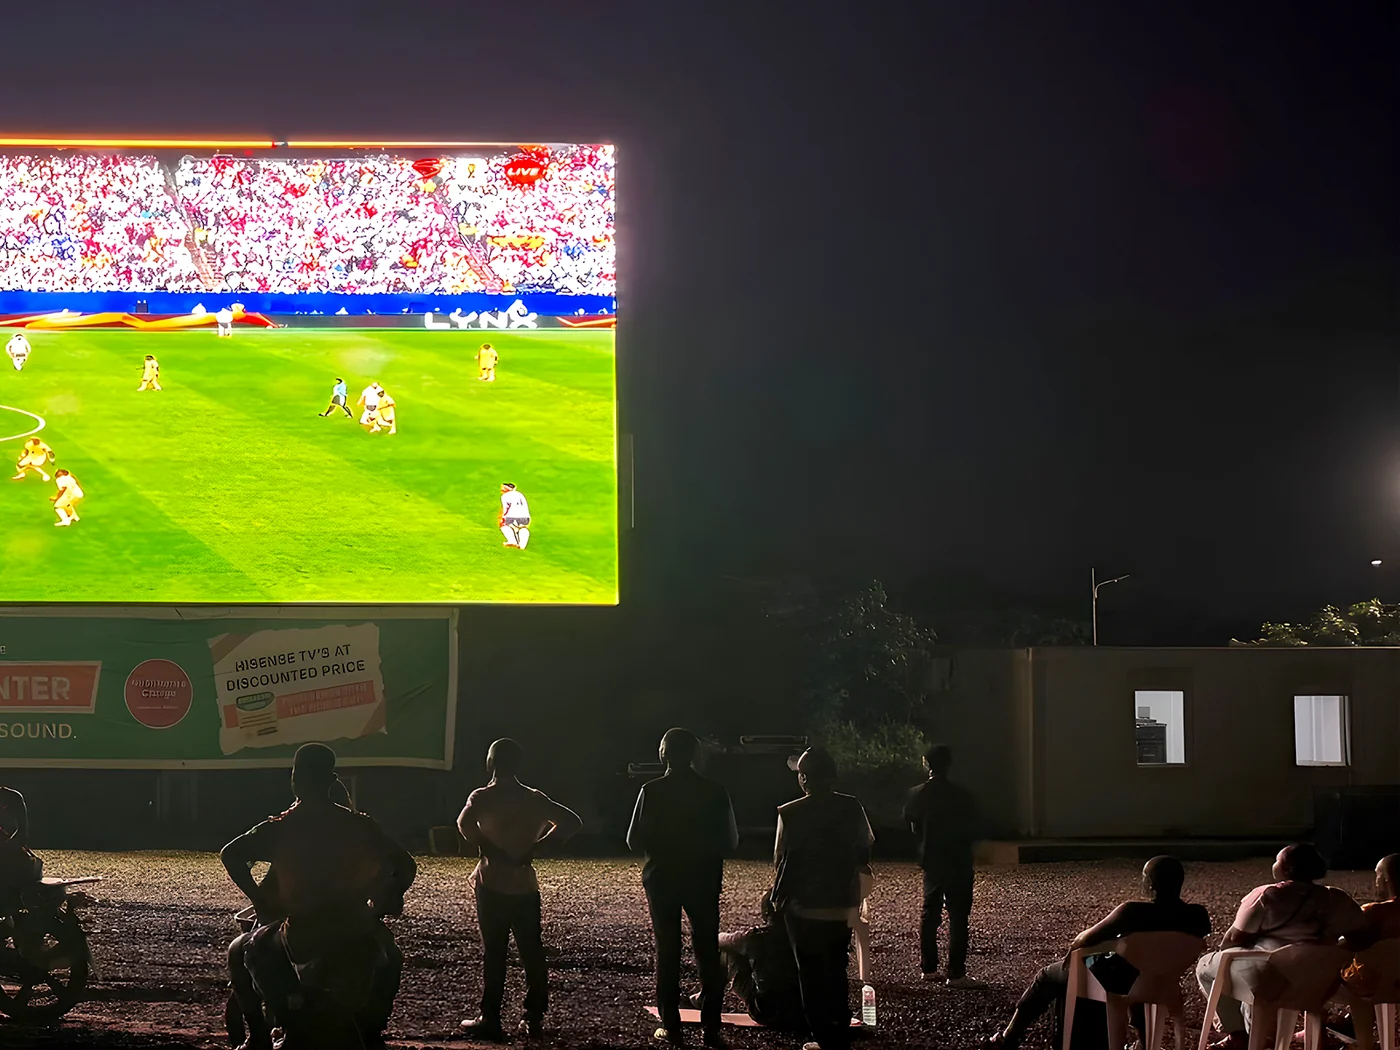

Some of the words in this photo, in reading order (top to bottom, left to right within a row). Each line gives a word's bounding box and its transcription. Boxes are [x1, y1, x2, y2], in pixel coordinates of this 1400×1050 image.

[506, 166, 541, 177] LIVE
[424, 310, 538, 329] LYNX
[235, 652, 296, 672] HISENSE
[334, 644, 351, 657] AT
[226, 667, 318, 692] DISCOUNTED
[322, 660, 366, 677] PRICE
